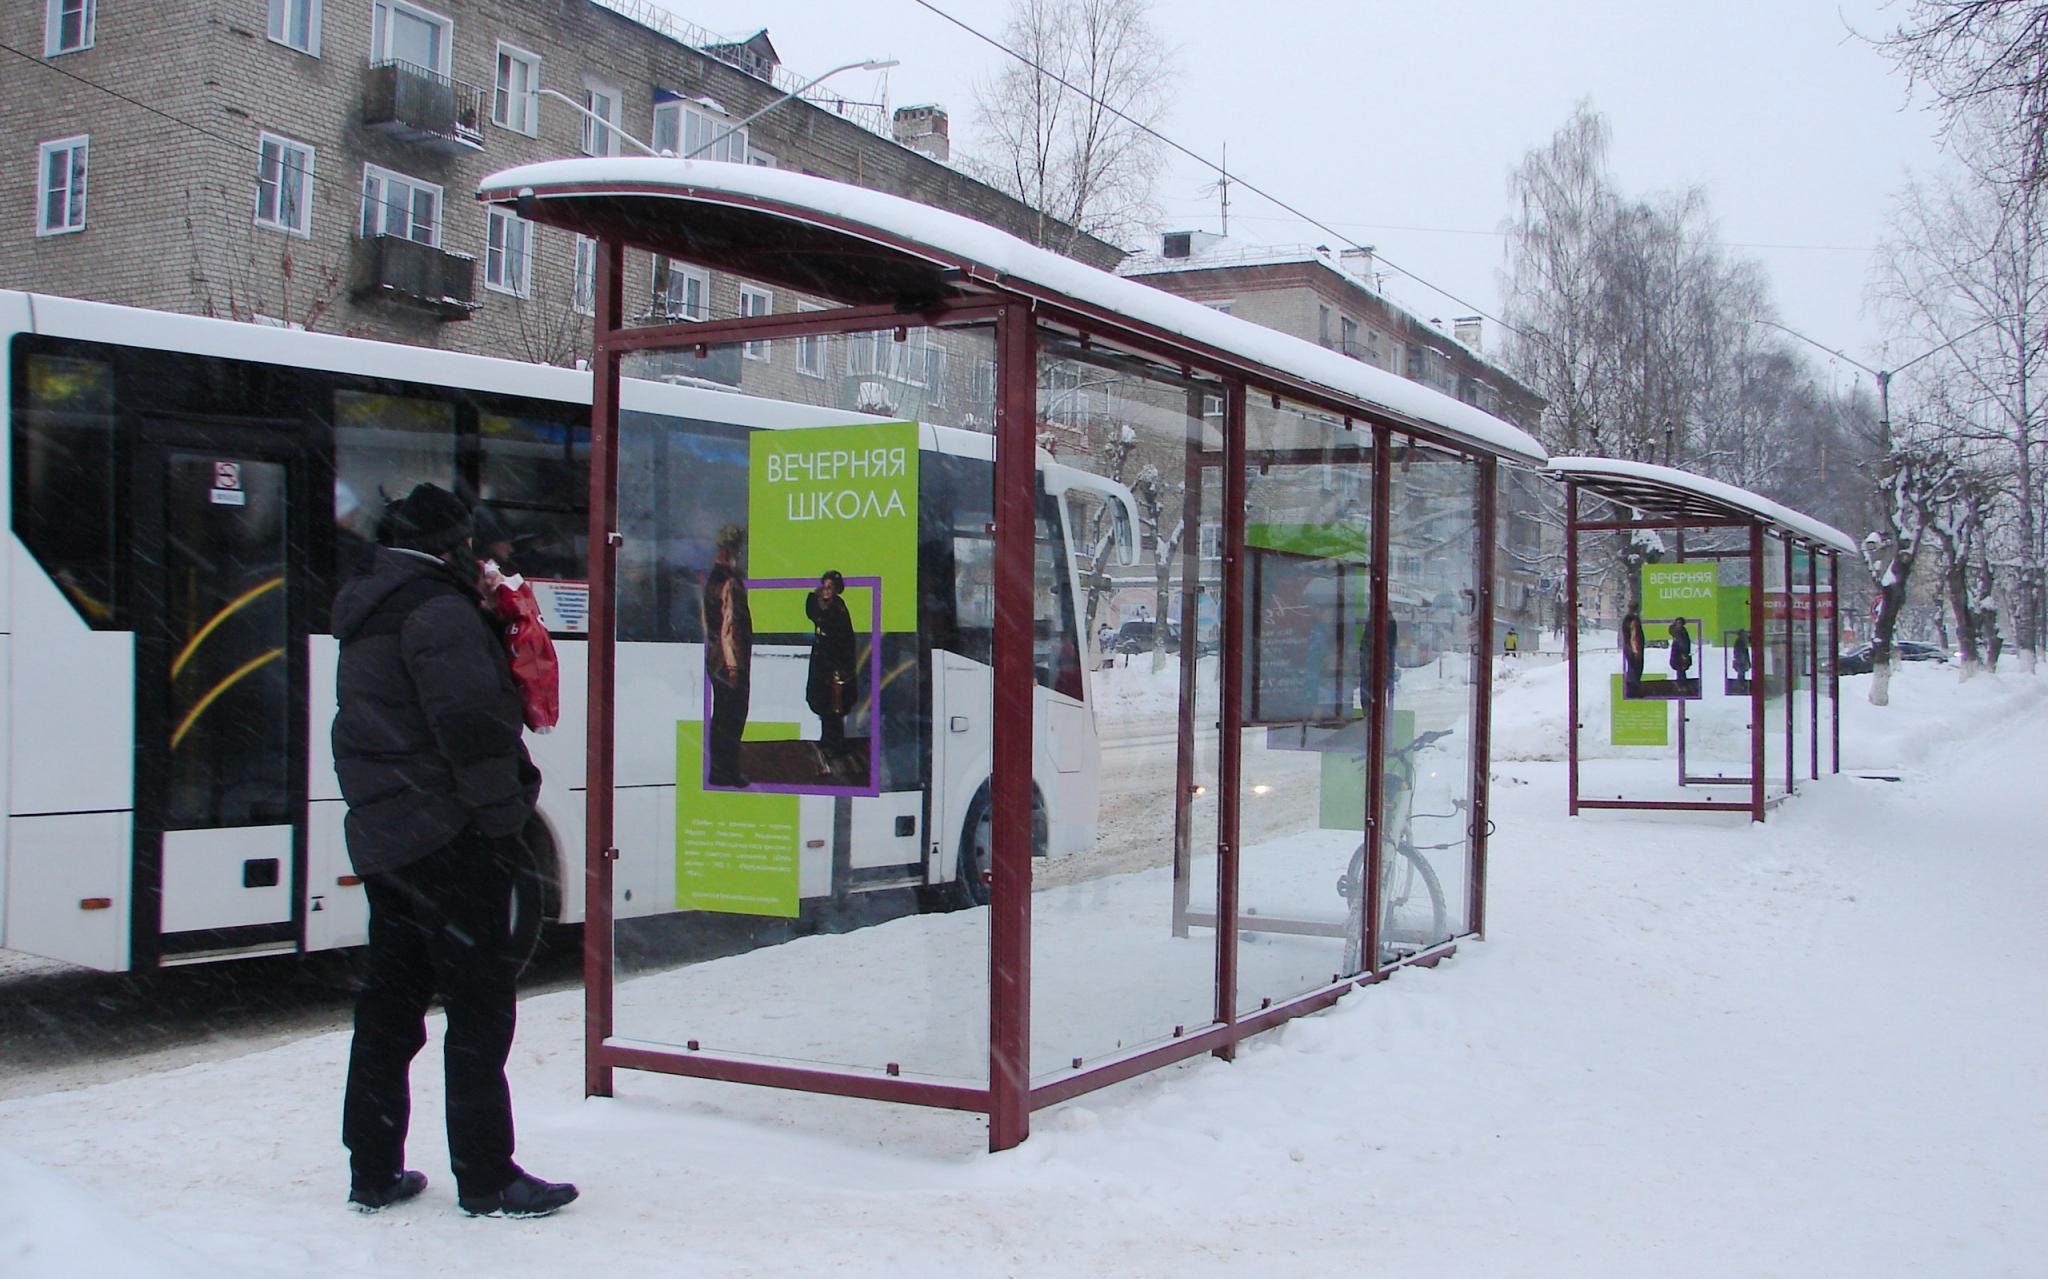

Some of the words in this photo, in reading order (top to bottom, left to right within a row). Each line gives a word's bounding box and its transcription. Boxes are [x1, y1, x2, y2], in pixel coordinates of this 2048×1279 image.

[768, 447, 905, 482] ВЕЧЕРНЯЯ
[788, 489, 906, 520] ШКОЛА
[1649, 571, 1712, 584] ВЕЧЕРНЯЯ
[1660, 587, 1712, 599] ШКОЛА
